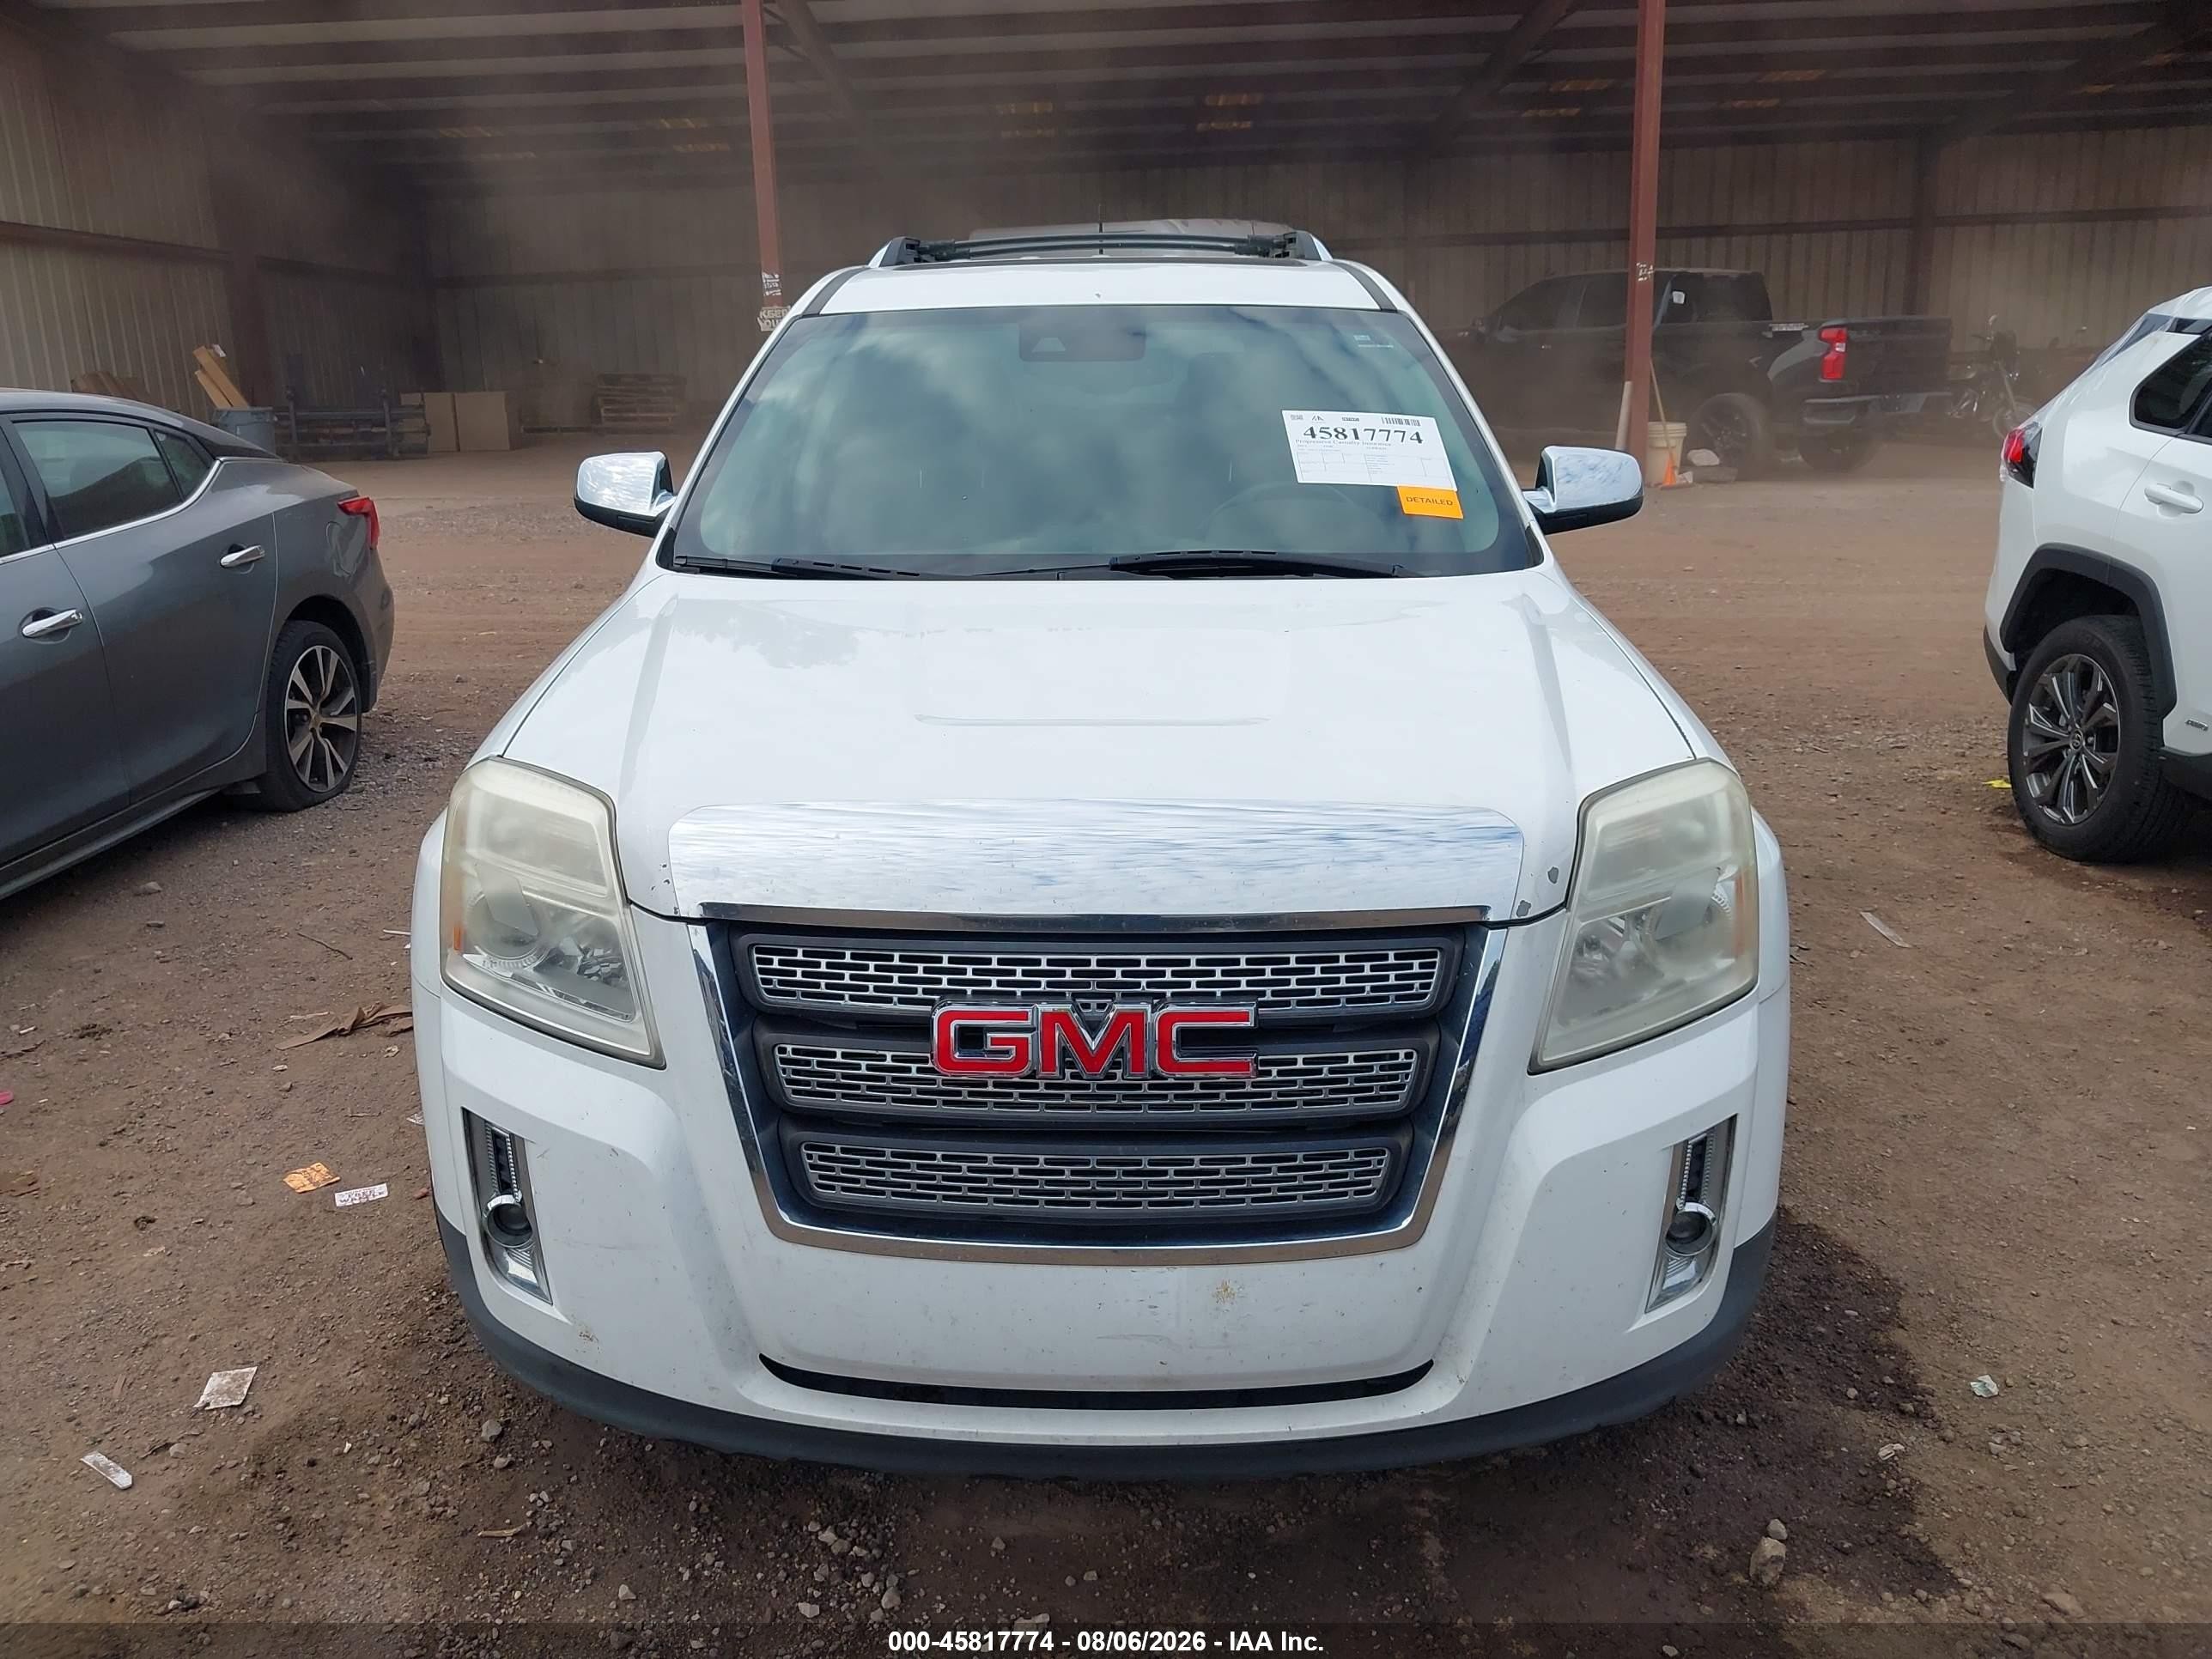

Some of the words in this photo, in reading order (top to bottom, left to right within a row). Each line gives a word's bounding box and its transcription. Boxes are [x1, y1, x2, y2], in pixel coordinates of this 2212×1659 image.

[1304, 426, 1423, 444] 45817774
[1406, 496, 1453, 506] DETAILED
[933, 1001, 1257, 1078] GMC
